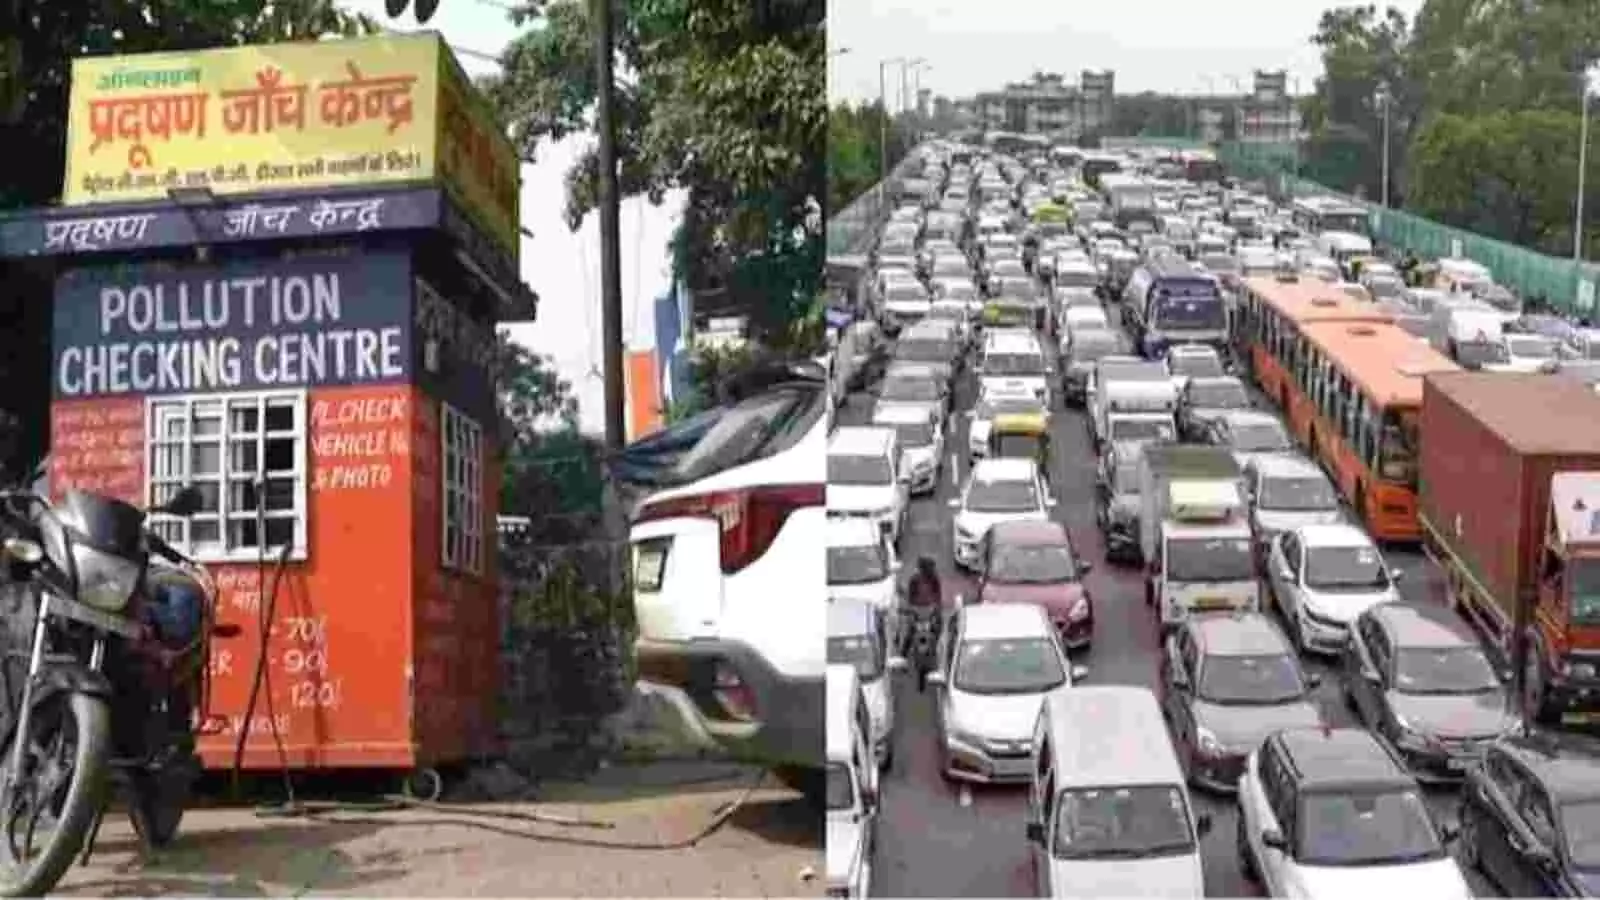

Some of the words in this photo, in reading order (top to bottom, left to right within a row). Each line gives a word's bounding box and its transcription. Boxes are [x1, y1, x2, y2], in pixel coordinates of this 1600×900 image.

[88, 92, 209, 168] प्रदूषण
[220, 66, 307, 133] जाँच
[320, 59, 418, 136] केन्द्र
[45, 212, 156, 250] प्रदूषण
[308, 198, 385, 231] केन्द्र
[101, 273, 341, 334] POLLUTION
[59, 336, 241, 395] CHECKING
[253, 327, 403, 384] CENTRE
[311, 430, 387, 457] VEHICLE
[331, 463, 392, 489] PHOTO
